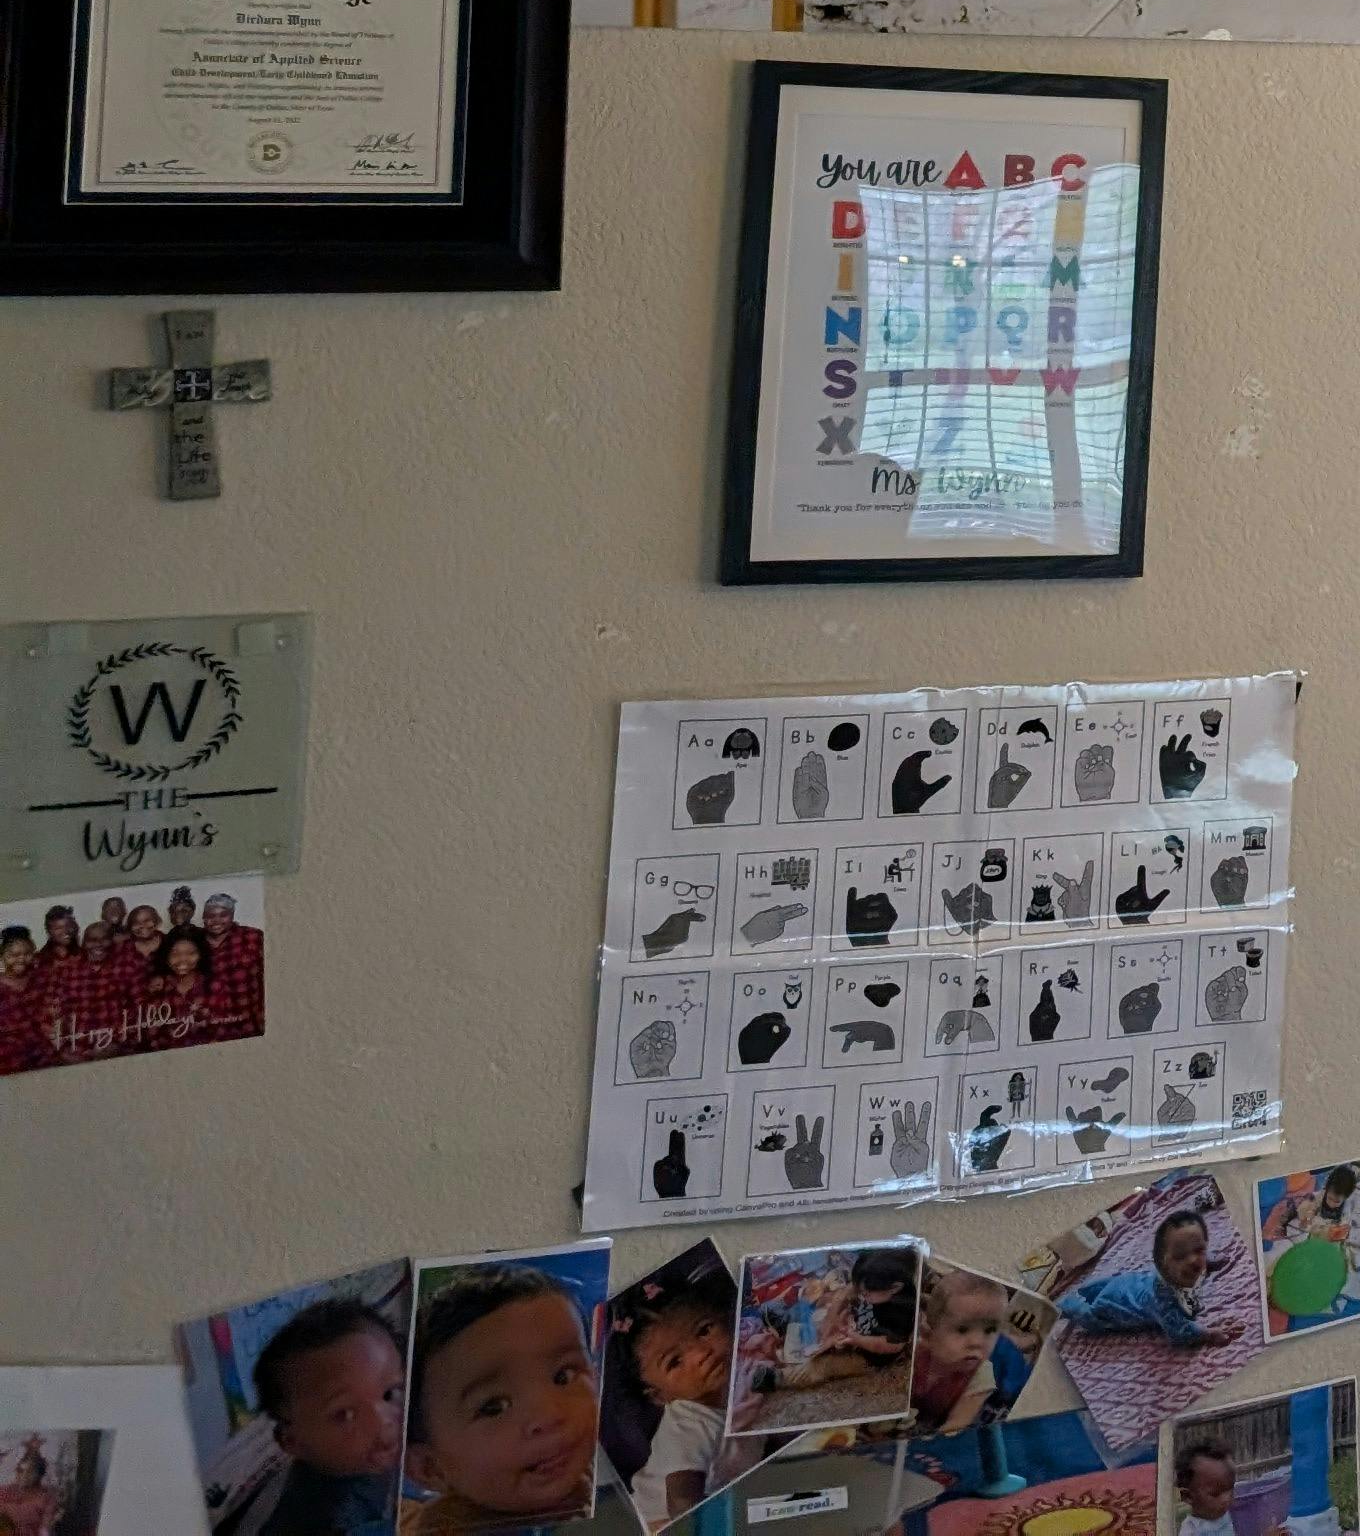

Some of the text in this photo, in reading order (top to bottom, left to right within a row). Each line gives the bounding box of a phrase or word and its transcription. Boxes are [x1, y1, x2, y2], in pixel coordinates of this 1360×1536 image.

[887, 159, 942, 187] are
[943, 150, 987, 190] A
[1004, 154, 1035, 187] B
[1051, 153, 1088, 191] C
[832, 201, 866, 239] D
[825, 306, 862, 345] N
[822, 360, 857, 400] S
[816, 415, 856, 456] X
[871, 466, 921, 495] Ms
[109, 678, 207, 746] W
[1074, 717, 1084, 732] E
[1162, 714, 1172, 728] F
[892, 726, 903, 741] C
[987, 722, 997, 736] D
[687, 734, 700, 748] A
[791, 730, 801, 745] B
[116, 787, 190, 812] THE
[1162, 1059, 1172, 1074] Z
[869, 1095, 885, 1110] W
[655, 1111, 666, 1125] U
[762, 1104, 774, 1119] V
